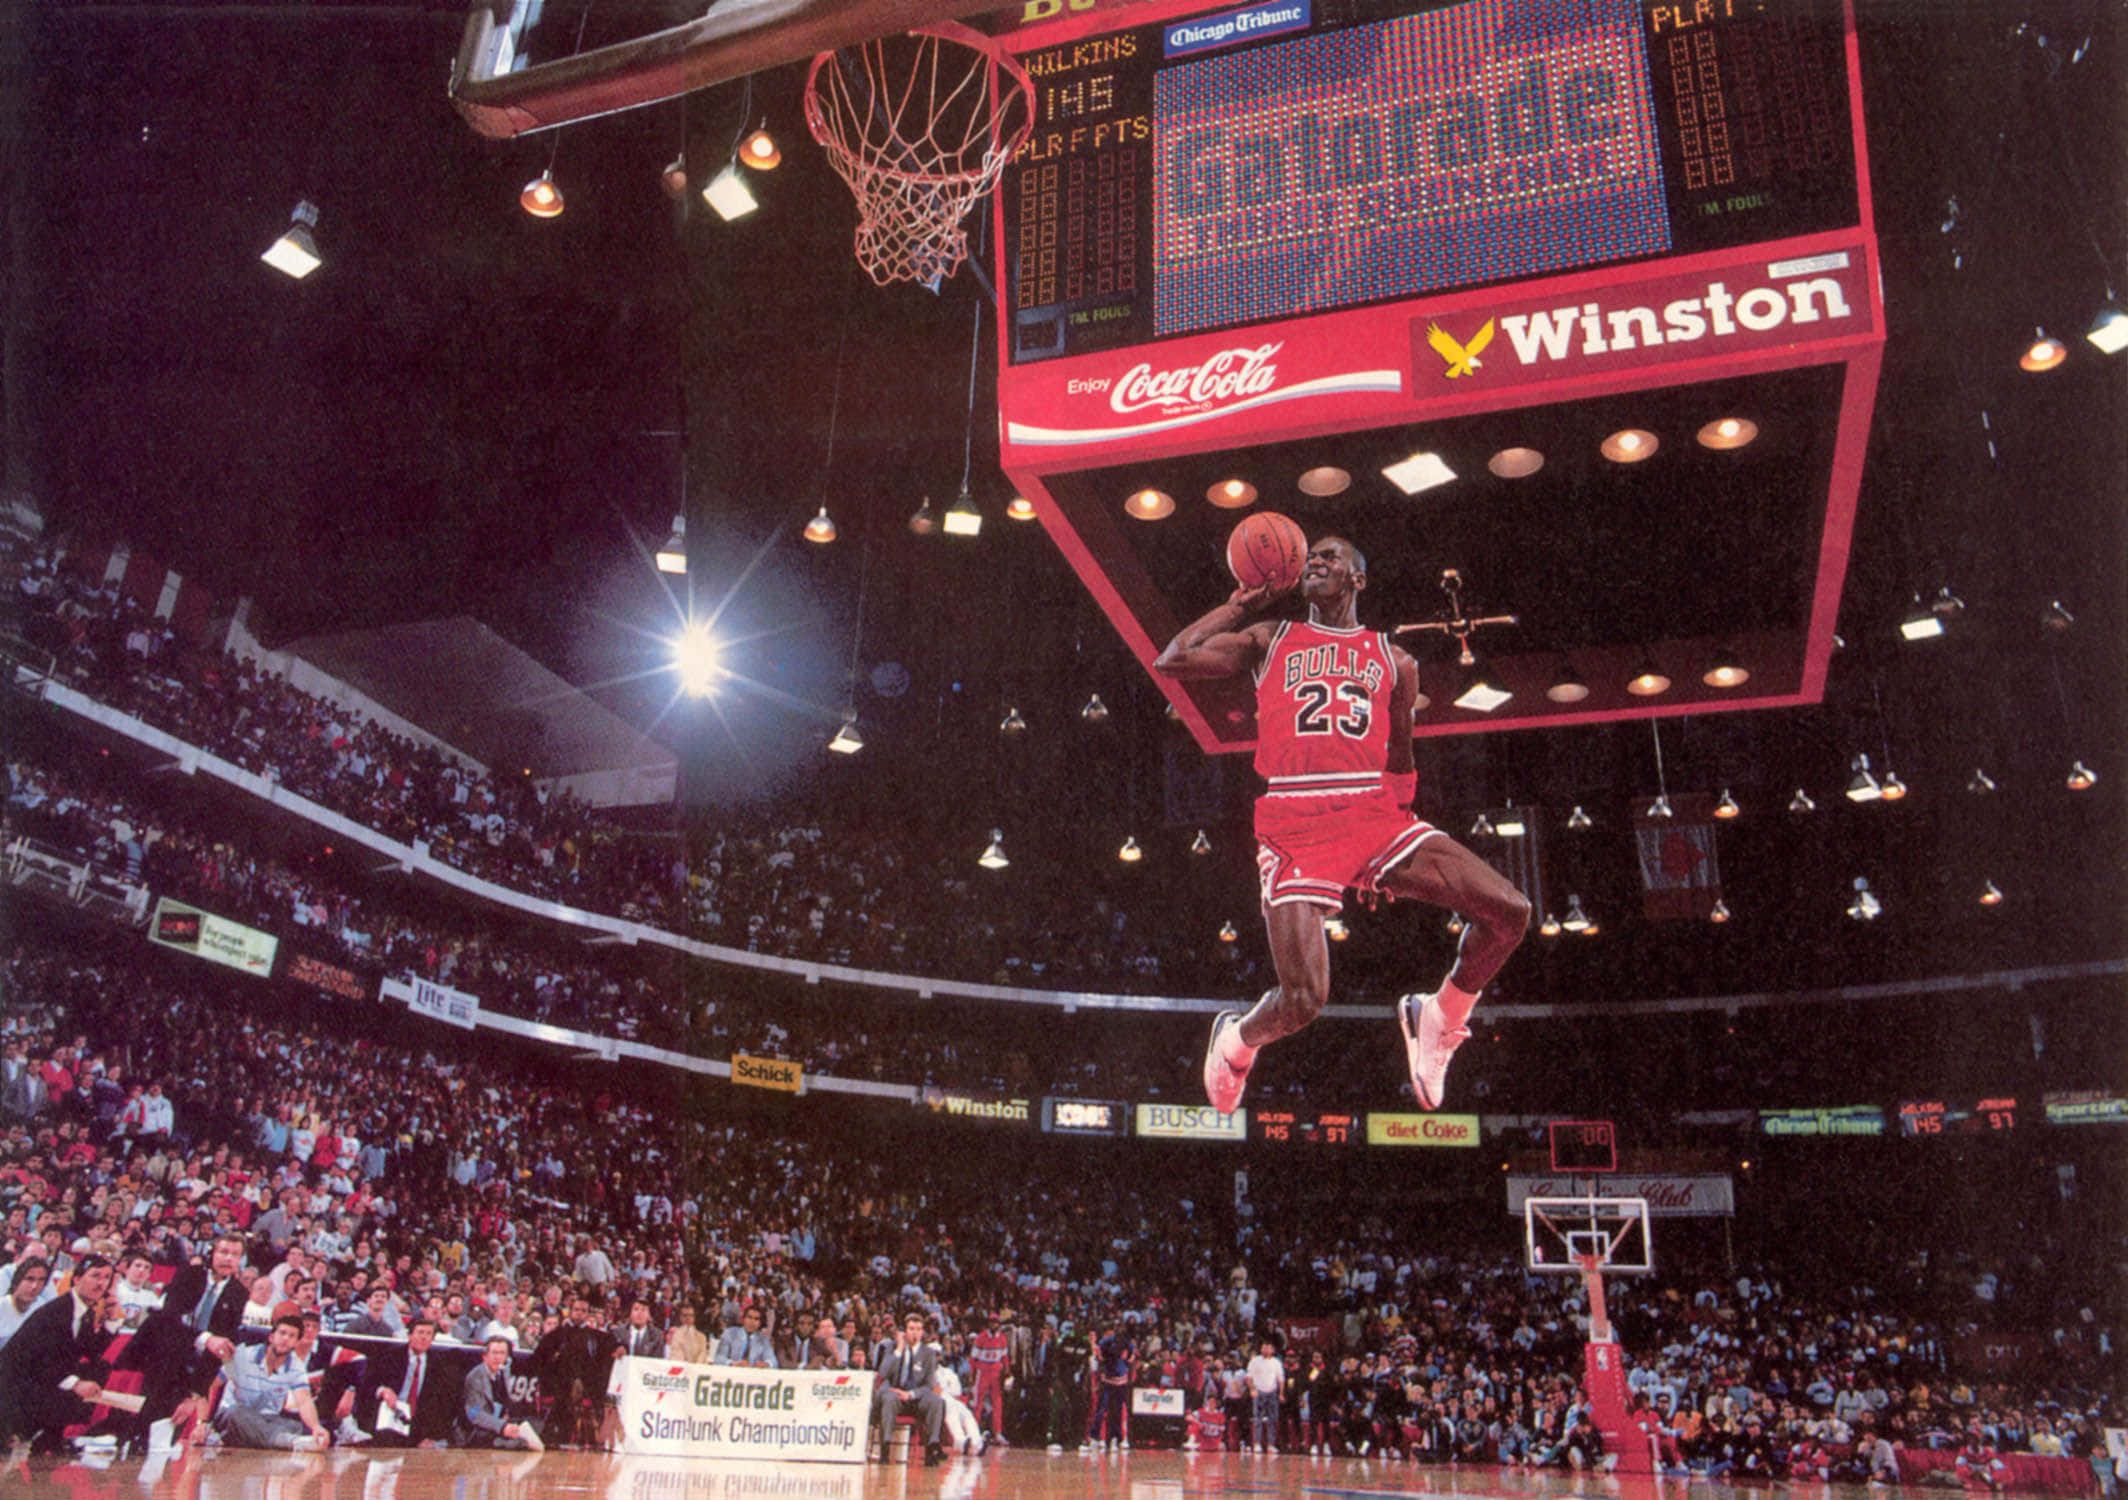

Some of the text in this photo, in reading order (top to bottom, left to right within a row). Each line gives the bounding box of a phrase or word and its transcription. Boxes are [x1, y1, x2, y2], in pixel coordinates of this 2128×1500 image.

[1170, 6, 1301, 47] Chicago Tribune
[1025, 34, 1137, 76] WILKINS
[1048, 75, 1113, 120] 145
[1500, 277, 1850, 364] Winston
[1067, 340, 1285, 413] Enjoy Coca-Cola
[1284, 643, 1383, 693] BULLS
[1295, 681, 1372, 740] 23
[737, 1061, 794, 1083] Schick
[945, 1097, 1028, 1120] Winston
[1149, 1106, 1233, 1128] BUSCH
[1912, 1115, 1942, 1135] 145
[1989, 1112, 2014, 1129] 97
[1386, 1120, 1468, 1139] diet Coke
[694, 1375, 795, 1410] Gatorade
[812, 1383, 861, 1398] Gatorade
[730, 1417, 855, 1451] Championship
